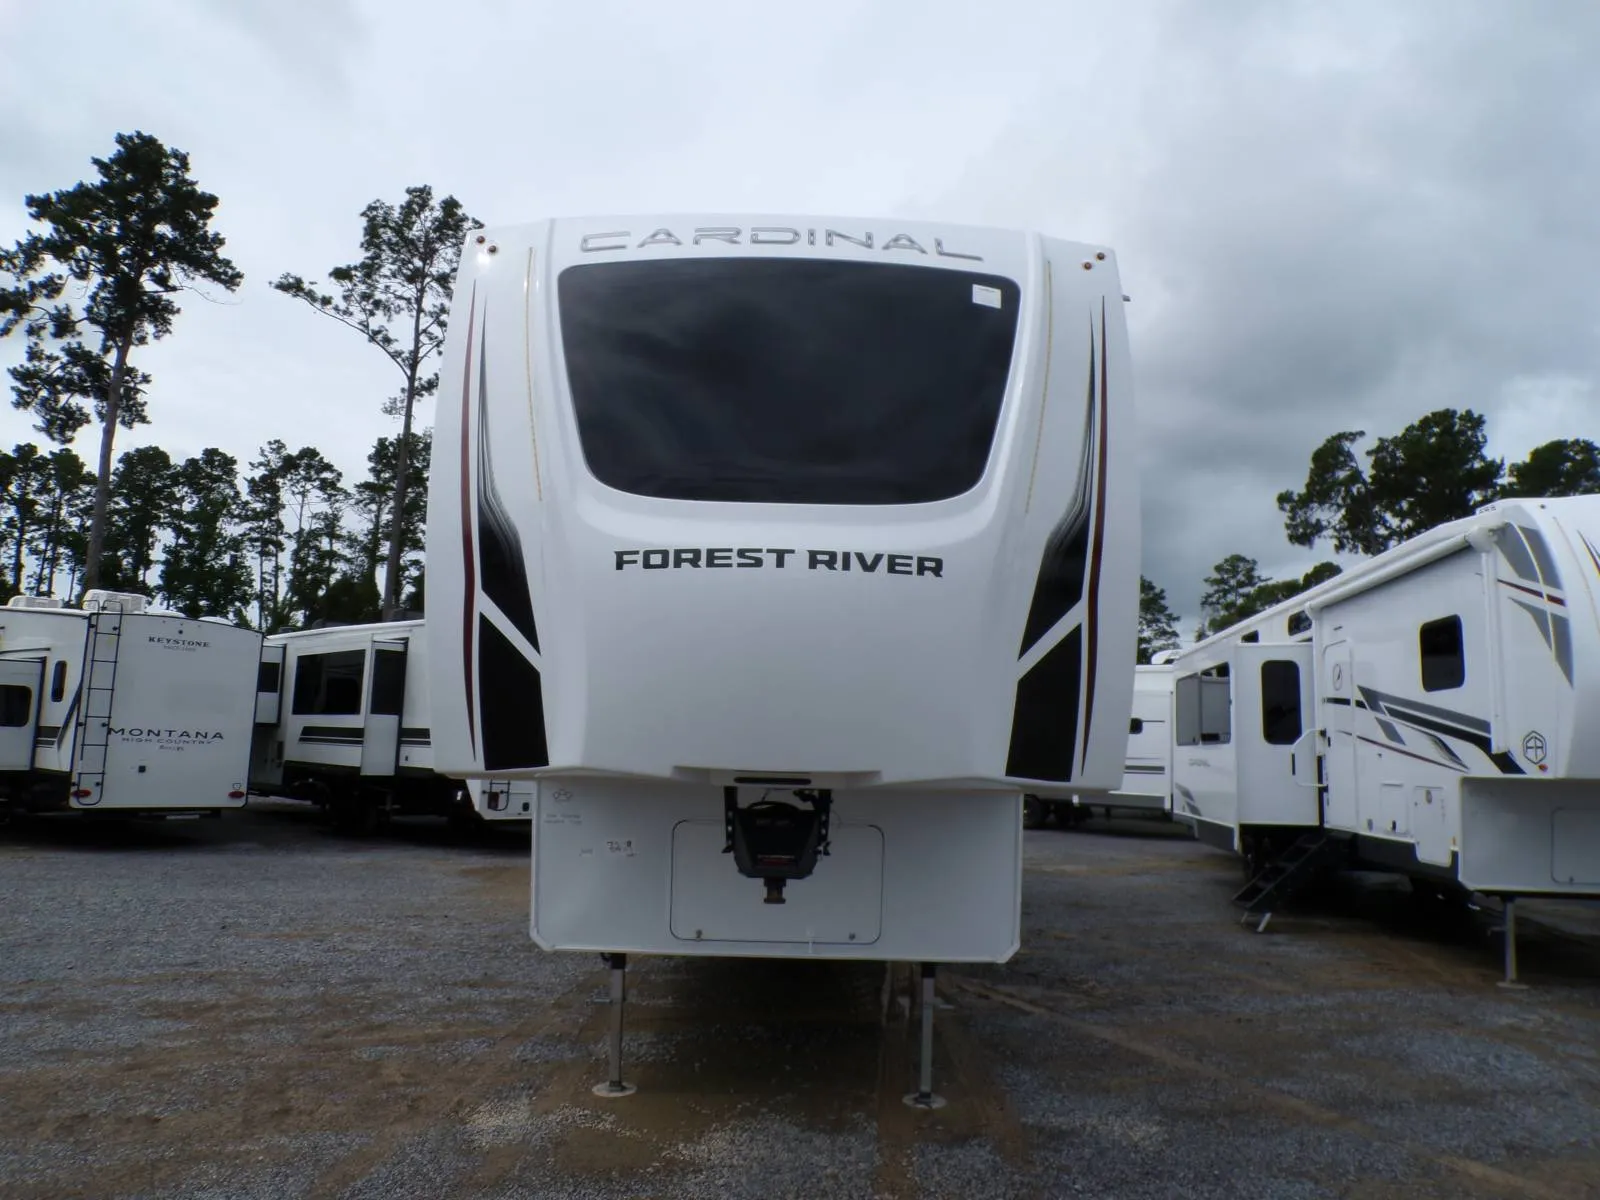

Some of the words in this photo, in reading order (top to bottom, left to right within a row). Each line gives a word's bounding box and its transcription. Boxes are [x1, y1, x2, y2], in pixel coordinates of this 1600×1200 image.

[580, 226, 984, 262] CARDINAL
[614, 548, 796, 571] FOREST
[806, 549, 944, 578] RIVER
[148, 636, 211, 648] KEYSTONE
[108, 728, 225, 740] MONTANA
